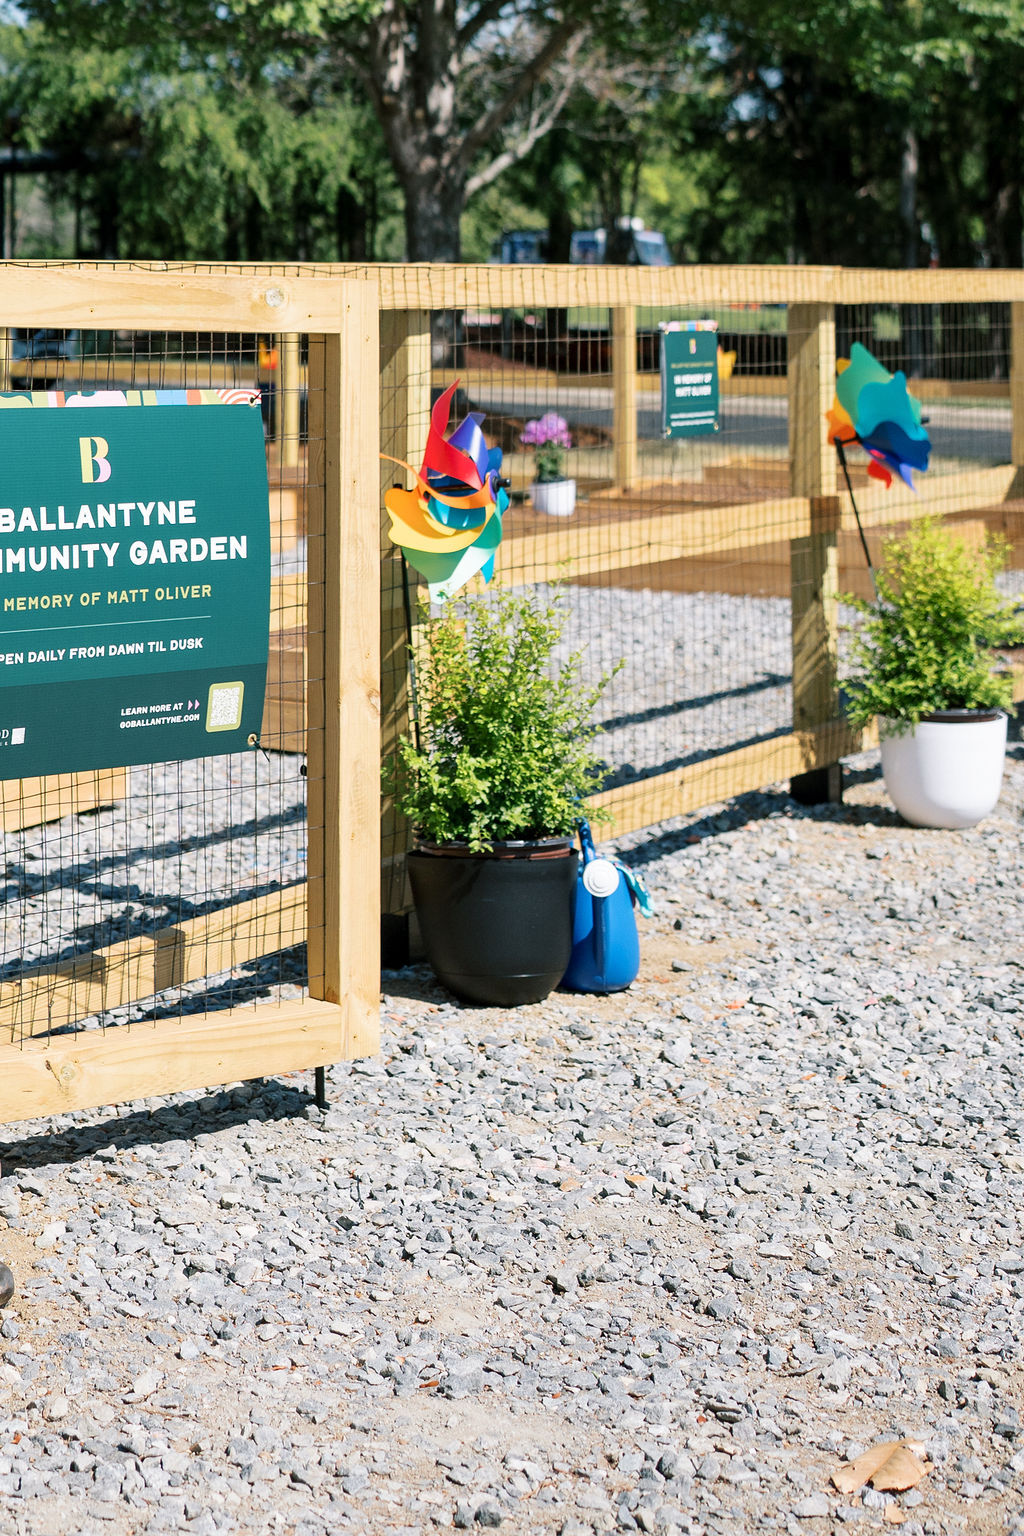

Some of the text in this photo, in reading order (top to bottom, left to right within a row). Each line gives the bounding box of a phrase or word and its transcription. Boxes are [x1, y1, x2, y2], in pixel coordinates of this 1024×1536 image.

[79, 436, 111, 483] B
[129, 535, 248, 565] GARDEN
[4, 593, 74, 612] MEMORY
[79, 592, 101, 606] OF
[107, 588, 149, 604] MATT
[154, 584, 212, 601] OLIVER
[28, 649, 66, 663] DAILY
[69, 645, 105, 660] FROM
[108, 642, 144, 657] DAWN
[147, 641, 166, 653] TIL
[170, 637, 204, 651] DUSK
[119, 713, 200, 729] GOBALLANTYNE.COM
[121, 702, 184, 716] LEARN MORE AT
